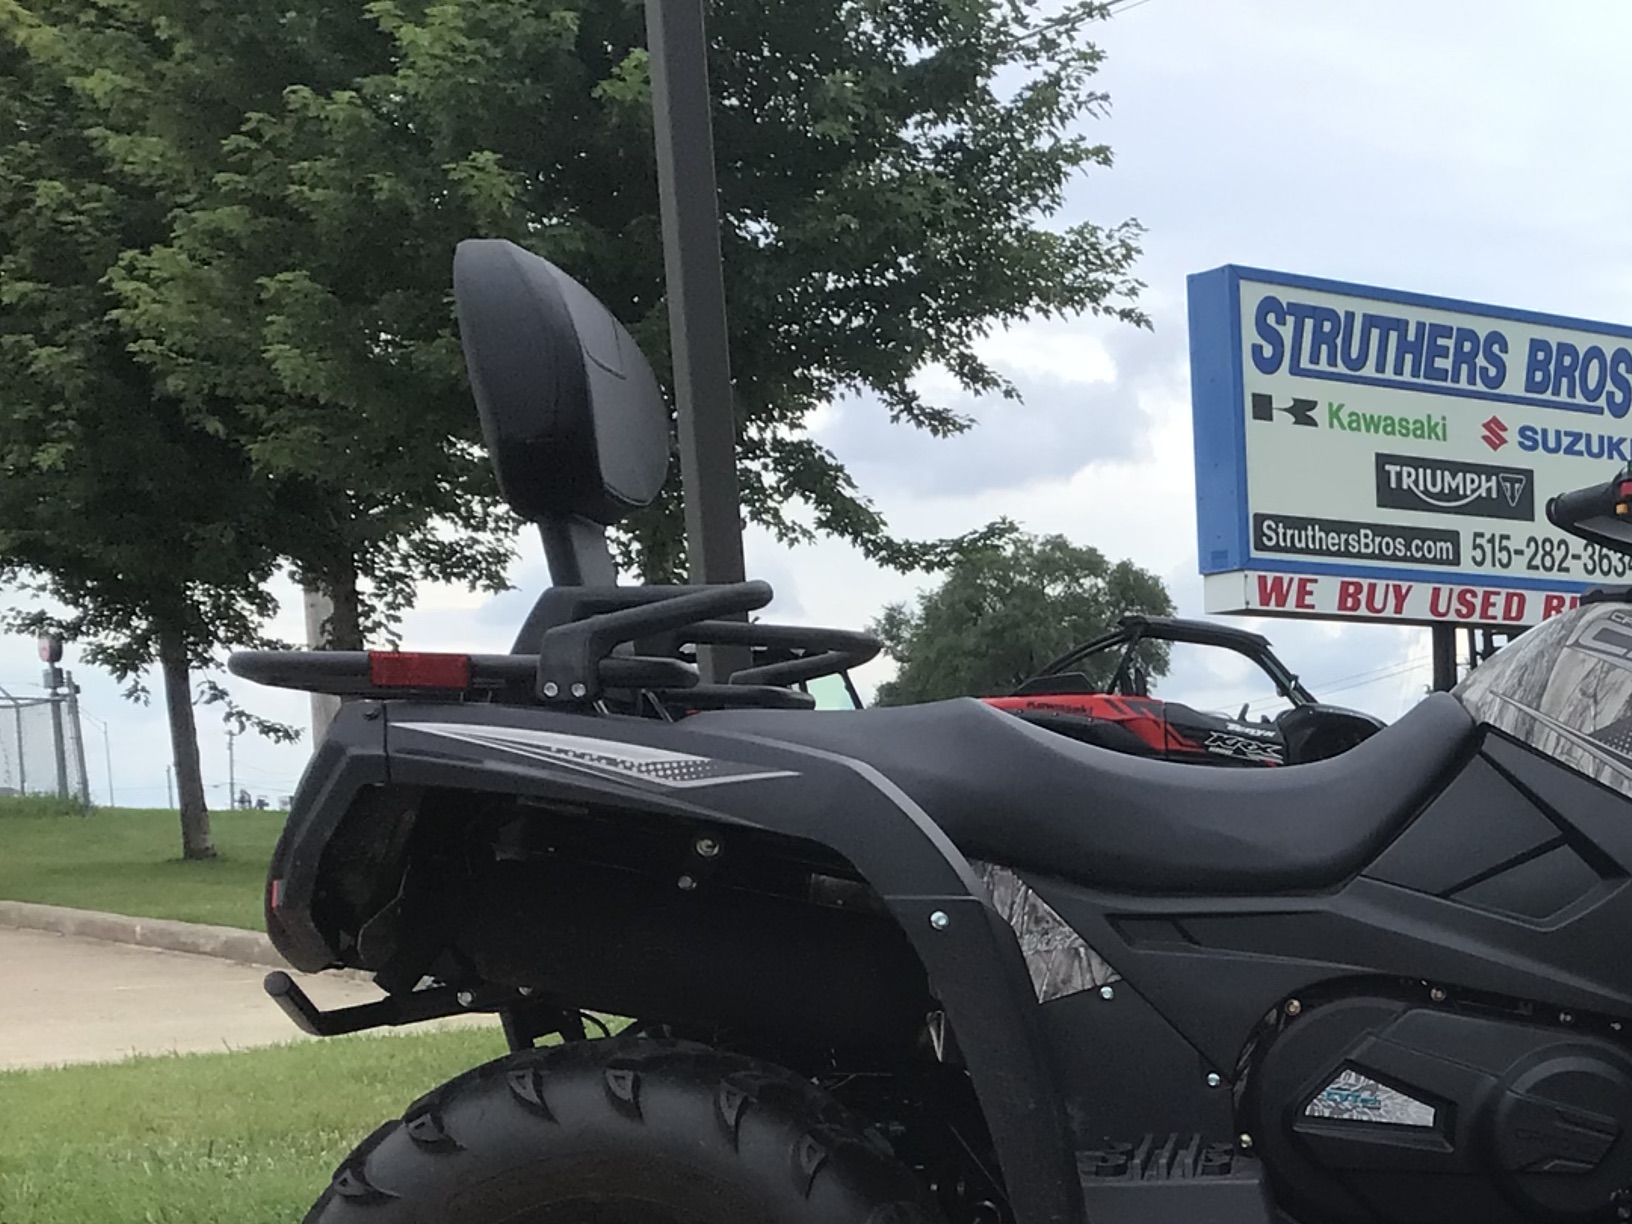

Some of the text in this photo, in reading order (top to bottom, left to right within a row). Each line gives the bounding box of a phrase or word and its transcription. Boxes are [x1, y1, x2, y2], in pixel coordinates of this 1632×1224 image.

[1251, 295, 1509, 390] STRUTHERS
[1327, 402, 1448, 442] Kawasaki
[1385, 464, 1498, 506] TRIUMPH
[1261, 519, 1454, 561] StruthersBros.com
[1256, 575, 1319, 610] WE
[1337, 579, 1413, 615] BUY
[1429, 587, 1526, 622] USED
